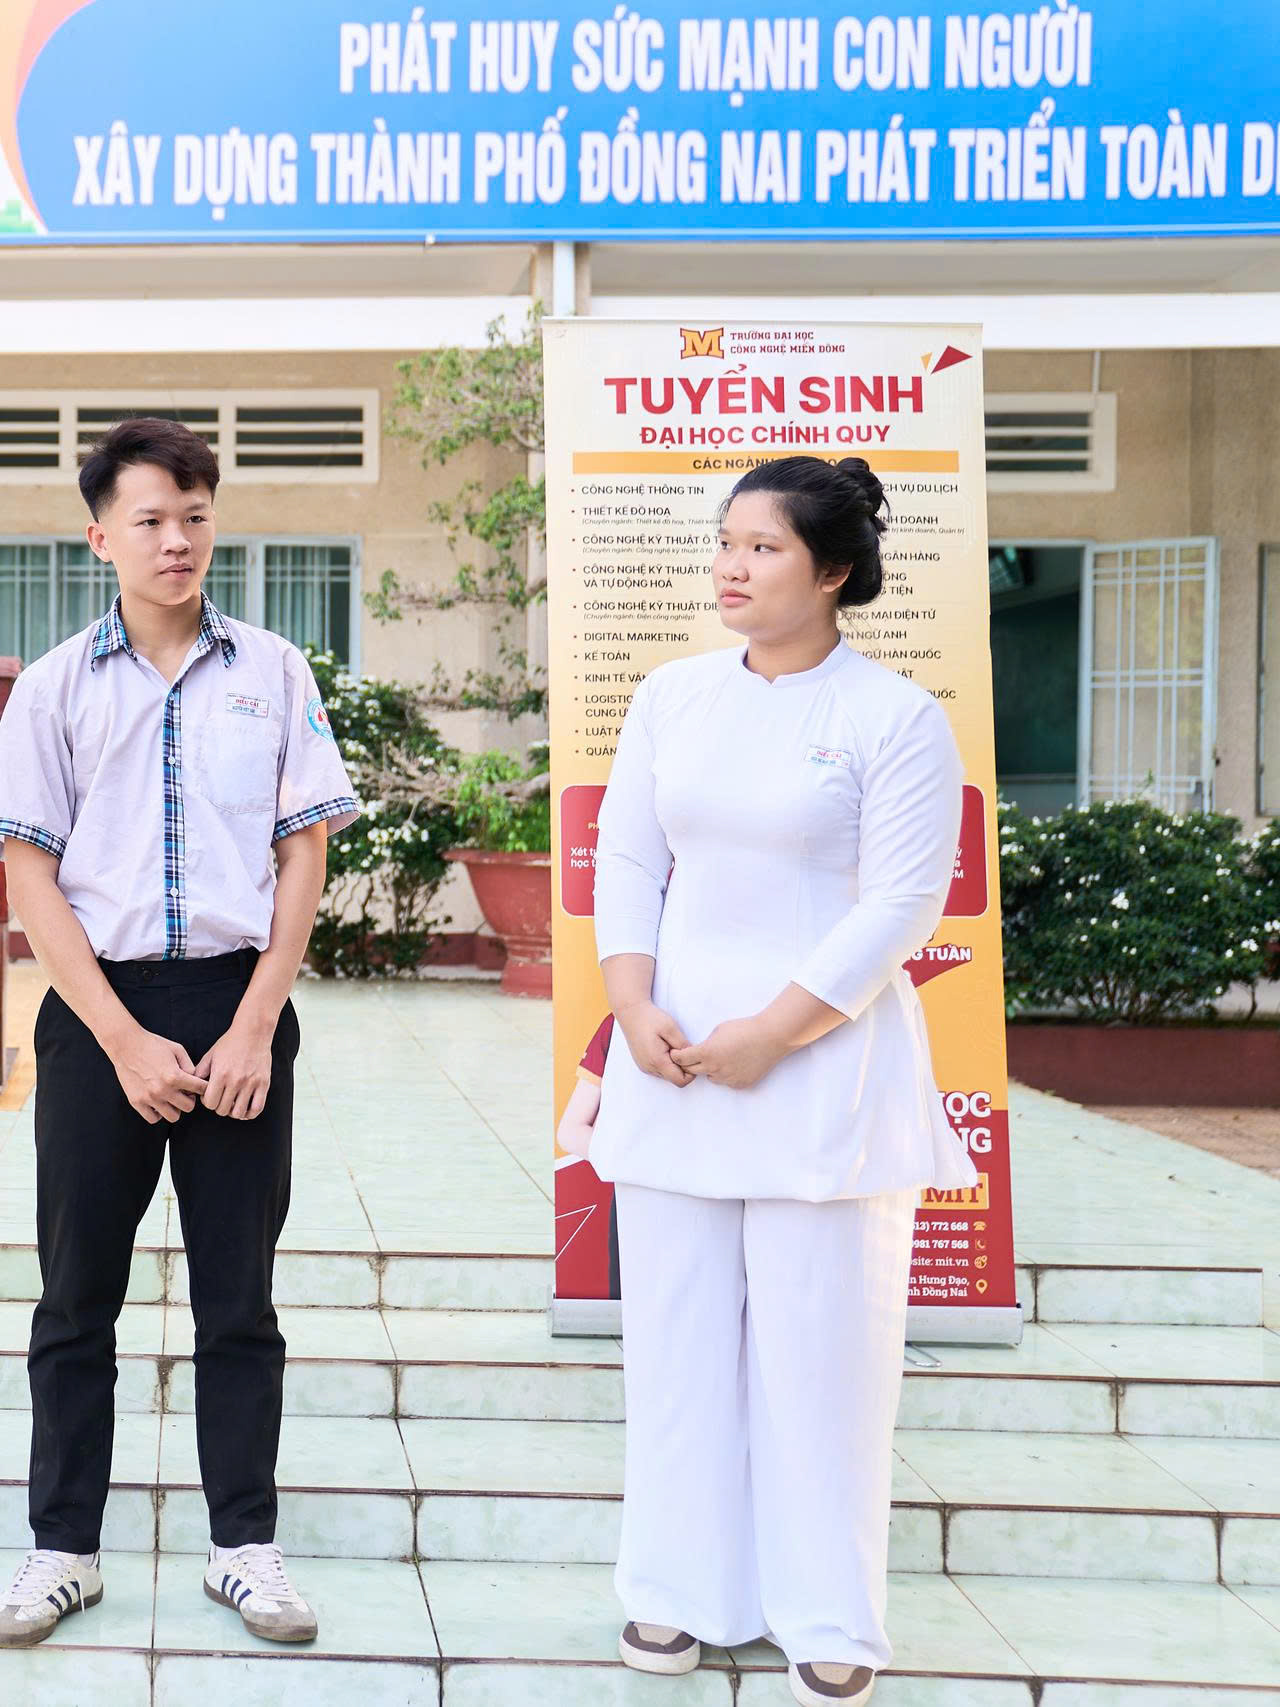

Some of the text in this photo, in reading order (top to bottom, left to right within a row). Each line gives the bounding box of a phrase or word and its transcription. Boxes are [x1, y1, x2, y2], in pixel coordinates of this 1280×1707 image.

[340, 0, 1092, 107] PHÁT HUY SỨC MẠNH CON NGƯỜI
[72, 120, 162, 206] XÂY
[173, 126, 299, 221] DỰNG
[310, 117, 460, 205] THÀNH
[475, 106, 567, 204] PHỐ
[579, 107, 707, 204] ĐỒNG
[721, 128, 801, 203] NAI
[816, 114, 937, 203] PHÁT
[948, 96, 1086, 201] TRIỂN
[1100, 108, 1228, 200] TOÀN
[730, 329, 771, 341] TRƯỜNG
[795, 331, 814, 344] HỌC
[680, 327, 724, 360] M
[730, 341, 845, 356] CÔNG NGHỆ MIỀN ĐÔNG
[604, 364, 923, 415] TUYỂN SINH
[640, 420, 891, 449] ĐẠI HỌC CHÍNH QUY
[693, 456, 721, 469] CÁC
[581, 484, 704, 497] CÔNG NGHỆ THÔNG TIN
[900, 484, 915, 494] VỤ
[917, 484, 932, 493] DU
[934, 484, 958, 495] LỊCH
[582, 504, 612, 516] THIẾT
[615, 504, 628, 516] KẾ
[630, 504, 646, 516] ĐỒ
[900, 515, 938, 525] DOANH
[583, 533, 614, 545] CÔNG
[616, 533, 646, 547] NGHỆ
[648, 533, 662, 545] KỸ
[665, 534, 700, 547] THUẬT
[702, 534, 711, 545] Ô
[910, 550, 940, 561] HÀNG
[583, 563, 615, 575] CÔNG
[617, 563, 646, 576] NGHỆ
[648, 563, 662, 575] KỸ
[666, 563, 700, 577] THUẬT
[584, 577, 598, 588] VÀ
[601, 577, 616, 589] TỰ
[617, 577, 648, 590] ĐỘNG
[890, 584, 913, 597] TIỆN
[584, 600, 615, 611] CÔNG
[618, 600, 646, 613] NGHỆ
[649, 600, 663, 611] KỸ
[666, 600, 701, 613] THUẬT
[871, 610, 892, 622] MẠI
[894, 609, 919, 621] ĐIỆN
[584, 632, 689, 642] DIGITAL MARKETING
[883, 630, 907, 639] ANH
[584, 649, 630, 661] KẾ TOÁN
[884, 648, 908, 659] HÀN
[910, 648, 942, 660] QUỐC
[585, 673, 610, 683] KINH
[613, 671, 626, 683] TẾ
[585, 695, 634, 705] LOGISTIC
[585, 708, 617, 718] CUNG
[585, 724, 612, 738] LUẬT
[586, 743, 618, 757] QUẢN
[570, 846, 587, 856] Xét
[571, 858, 589, 870] học
[926, 943, 972, 961] TUẦN
[937, 1091, 992, 1124] ỌC
[931, 1221, 949, 1231] 772
[912, 1239, 930, 1249] 981
[932, 1239, 950, 1249] 767
[911, 1256, 969, 1267] site: mit.vn
[948, 1275, 970, 1287] Đạo,
[922, 1285, 948, 1299] Đồng
[949, 1287, 968, 1297] Nai
